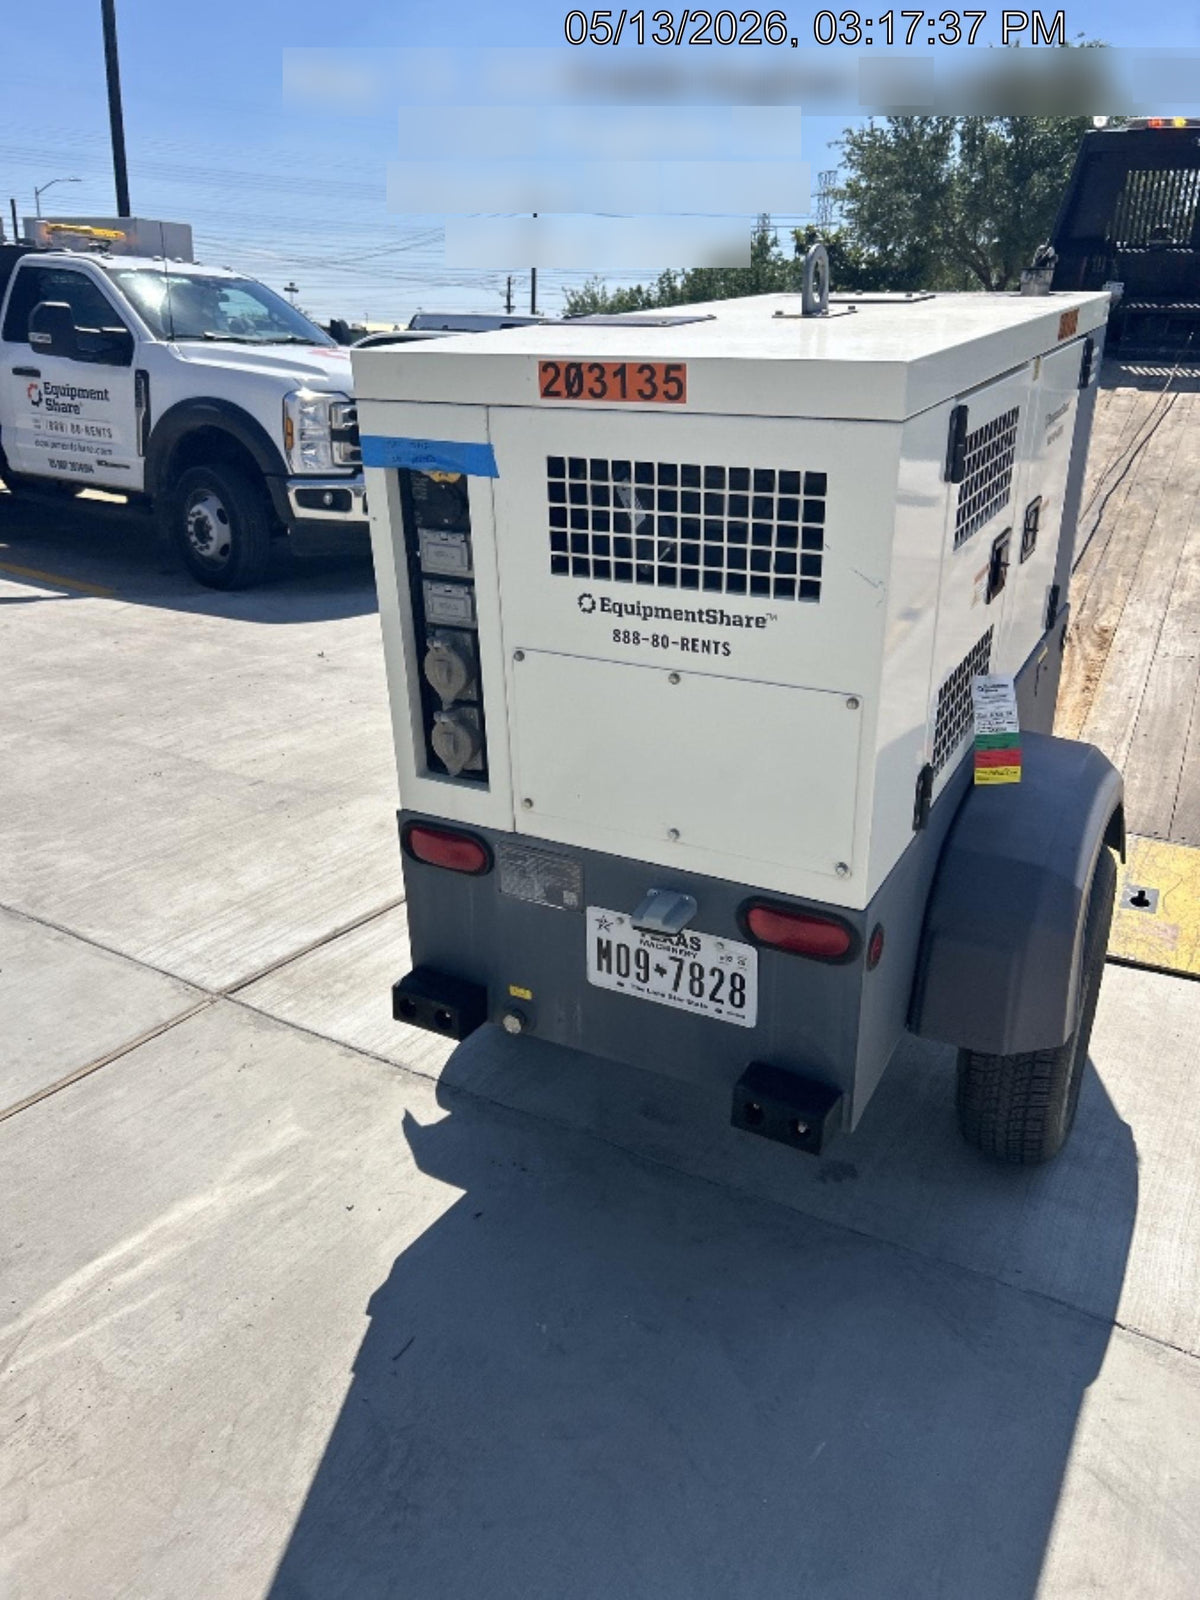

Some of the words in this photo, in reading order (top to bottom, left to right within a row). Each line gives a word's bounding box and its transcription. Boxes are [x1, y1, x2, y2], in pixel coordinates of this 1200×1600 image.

[43, 382, 110, 401] Equipment
[541, 362, 684, 401] 203135
[45, 398, 80, 415] Share
[612, 628, 731, 657] 888-80-RENTS
[640, 932, 702, 952] XAS
